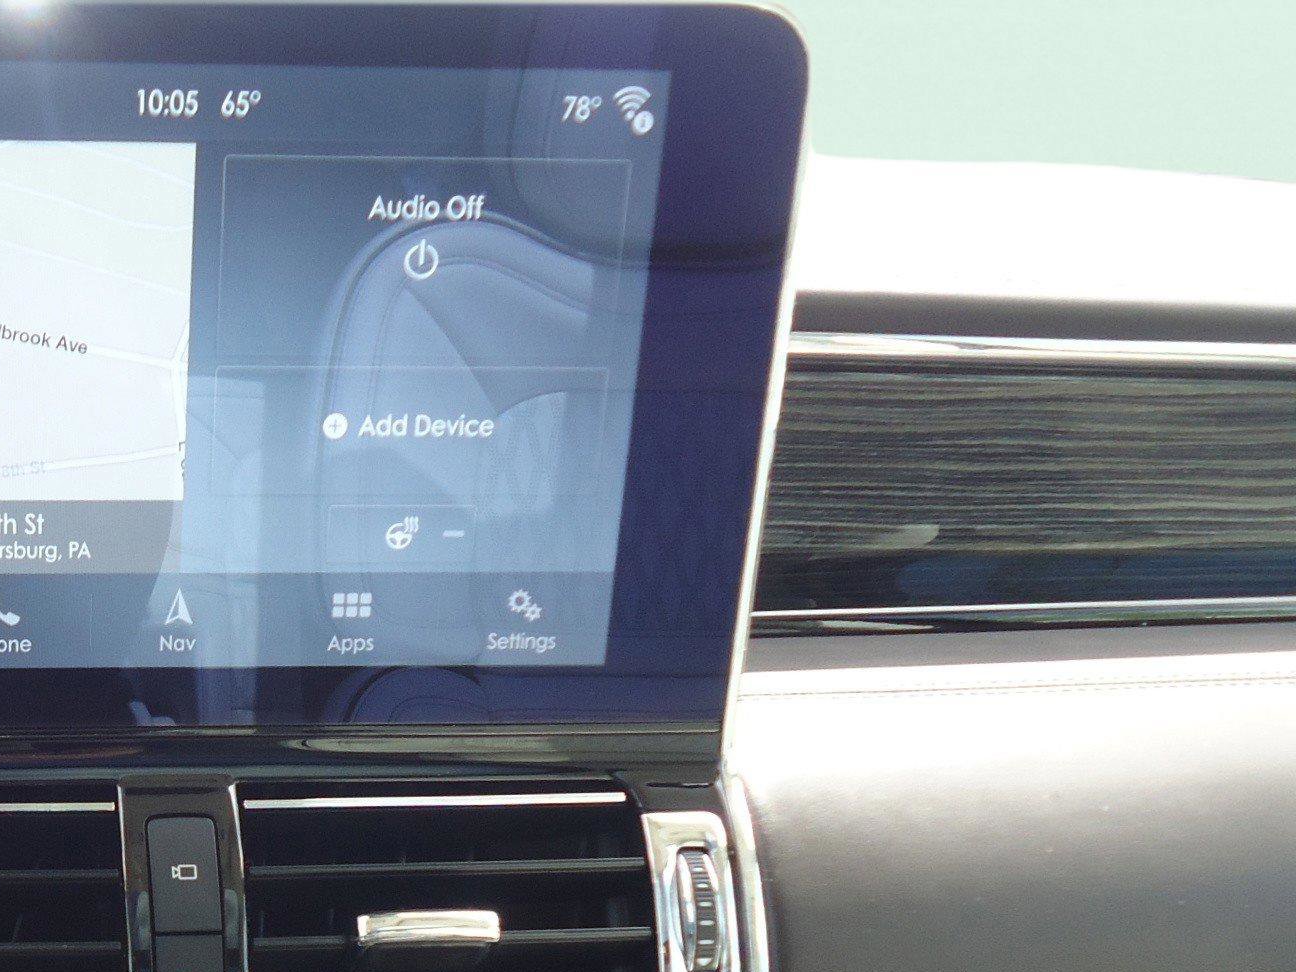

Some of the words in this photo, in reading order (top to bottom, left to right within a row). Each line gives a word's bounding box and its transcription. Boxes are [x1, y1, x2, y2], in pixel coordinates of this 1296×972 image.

[136, 88, 200, 118] 10:05
[368, 195, 439, 222] Audio
[447, 194, 485, 221] Off
[55, 334, 89, 355] Ave
[357, 413, 408, 439] Add
[414, 413, 495, 439] Device
[24, 512, 45, 536] St
[68, 542, 92, 560] PA
[159, 635, 196, 653] Nav
[326, 633, 374, 656] Apps
[487, 632, 556, 654] Settings
